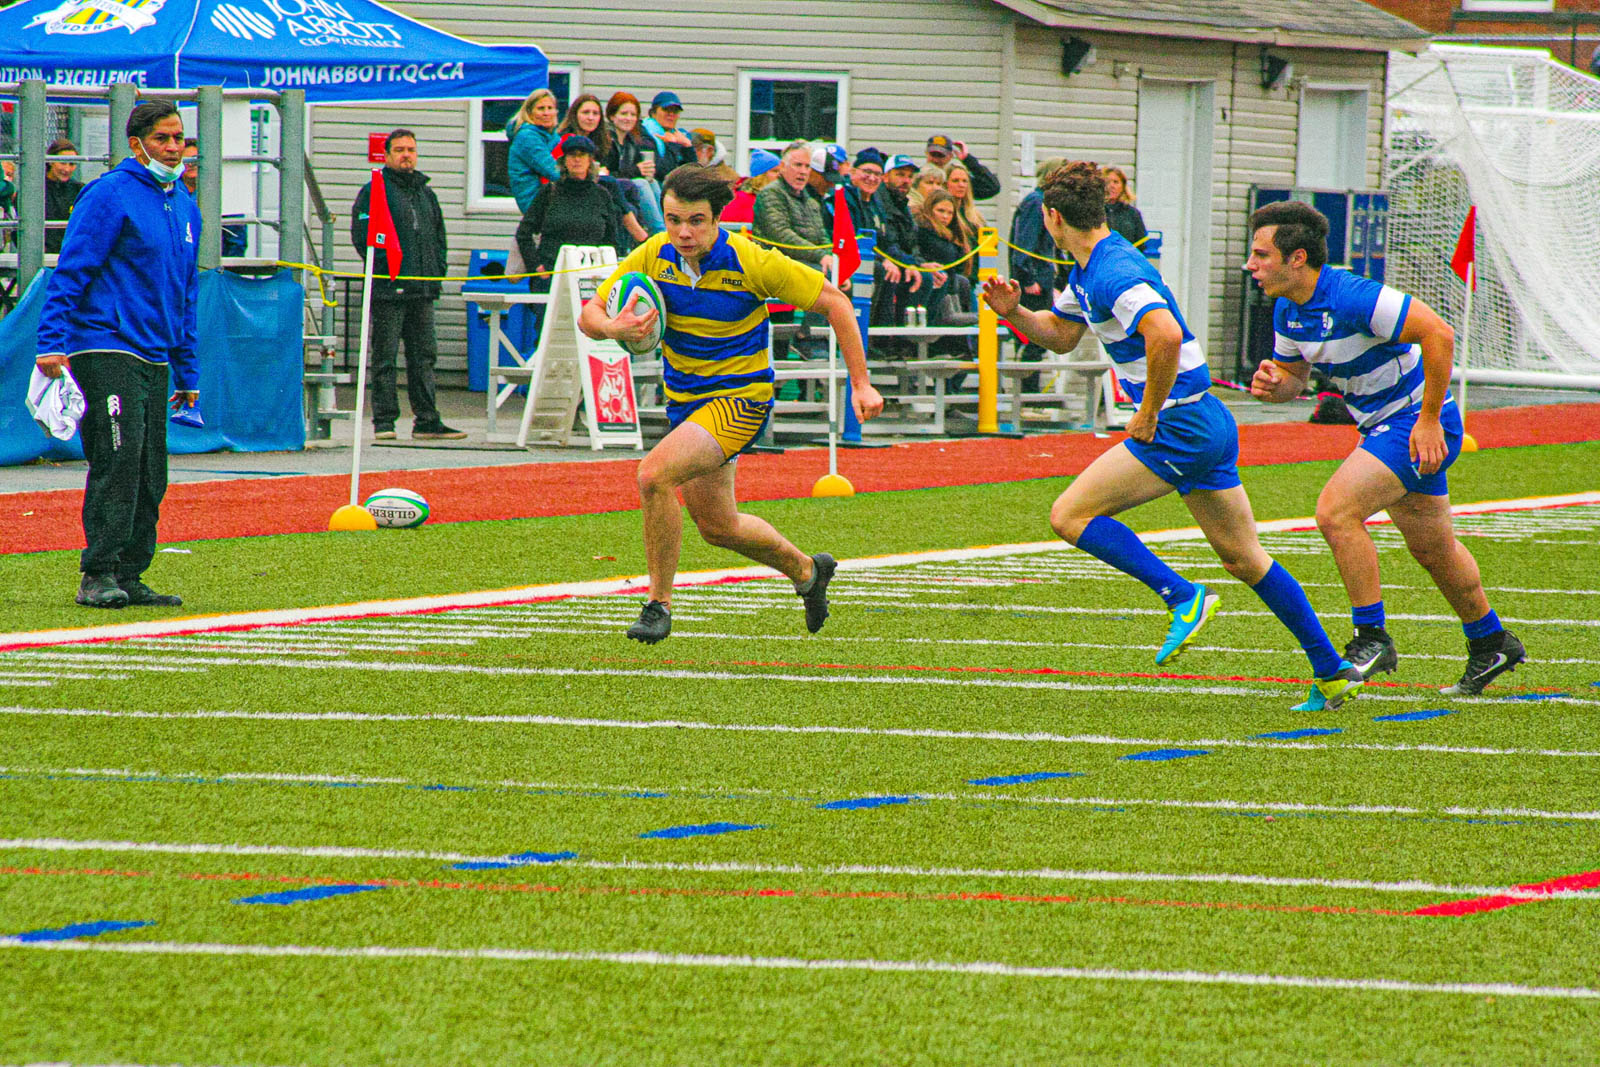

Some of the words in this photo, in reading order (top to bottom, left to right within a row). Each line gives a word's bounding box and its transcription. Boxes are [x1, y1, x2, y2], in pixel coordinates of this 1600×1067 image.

[261, 0, 355, 22] JOHN
[286, 15, 402, 40] ABBOTT
[0, 67, 43, 83] ITION
[54, 69, 148, 88] EXCELLENCE
[260, 62, 465, 87] JOHNABBOTT.QC.CA
[369, 508, 416, 520] GILBER
